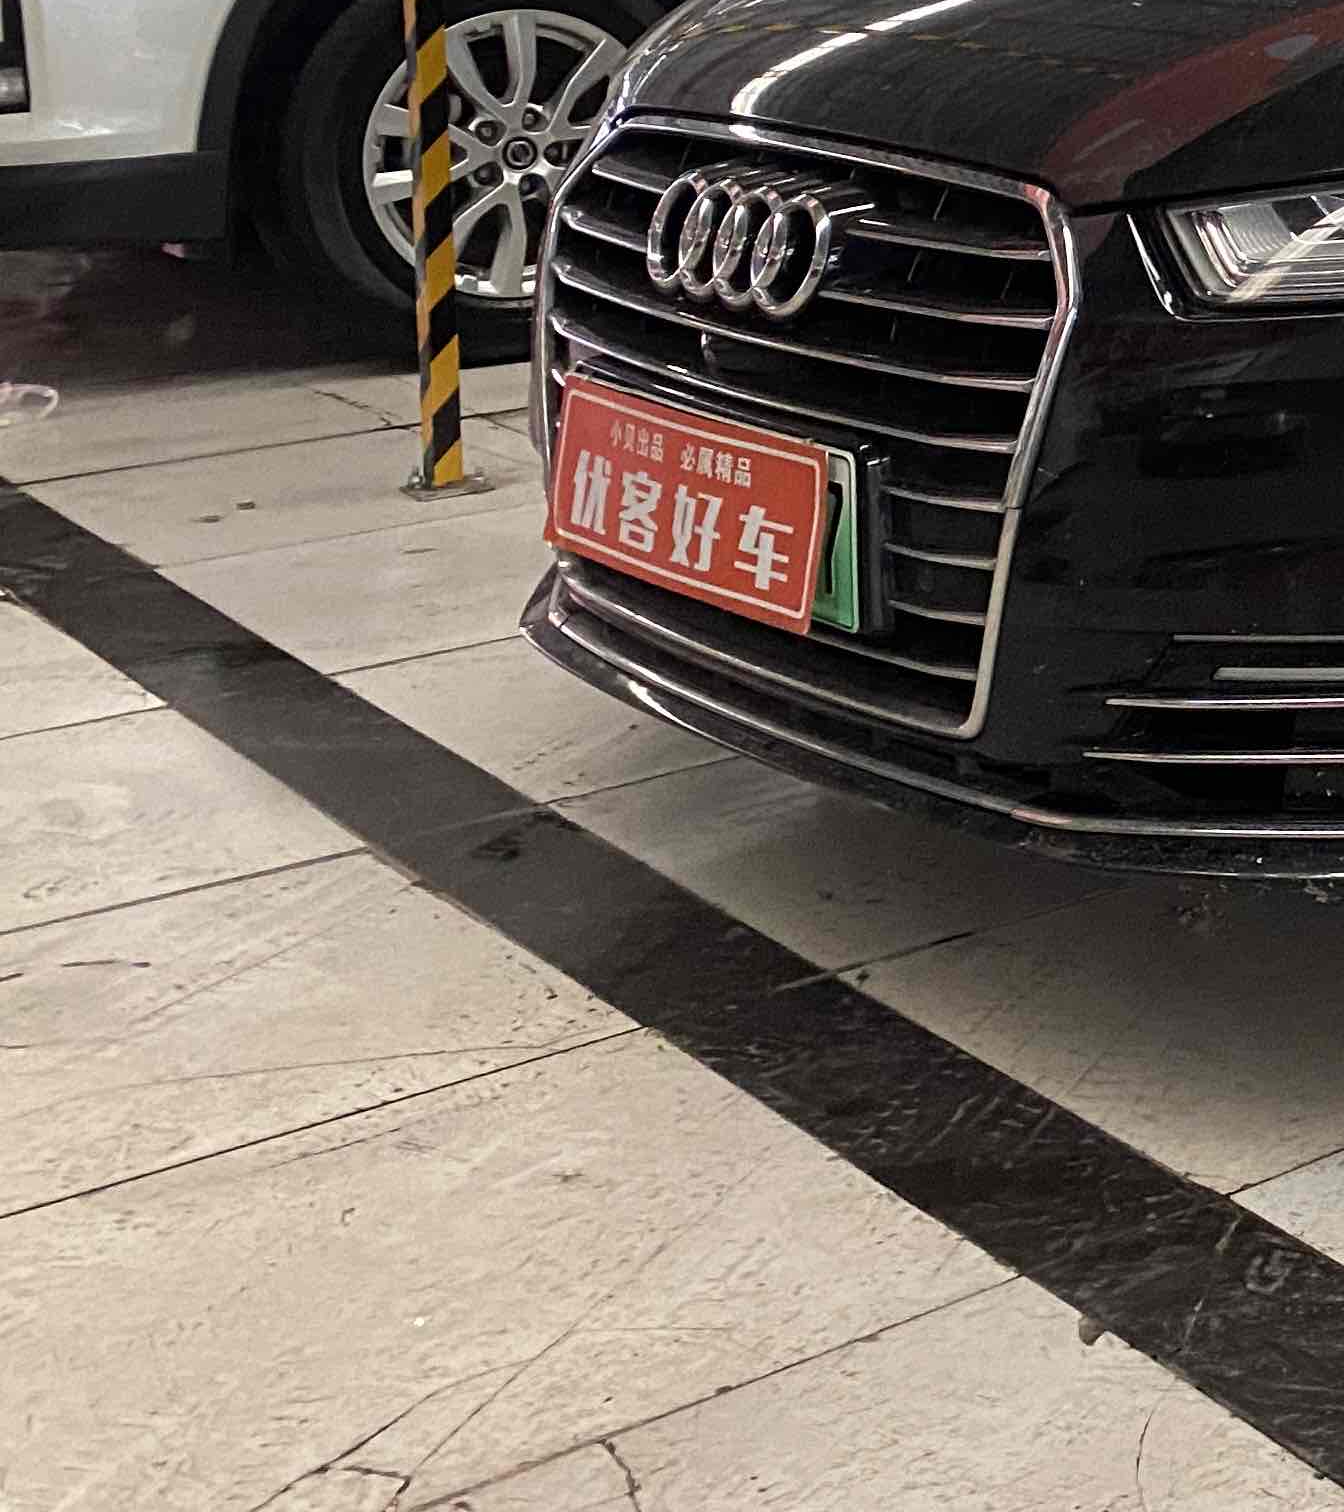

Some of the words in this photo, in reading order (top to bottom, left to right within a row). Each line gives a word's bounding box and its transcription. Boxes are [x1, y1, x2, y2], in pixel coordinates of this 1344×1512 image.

[679, 441, 753, 488] 必属精品
[570, 449, 794, 591] 优客好车
